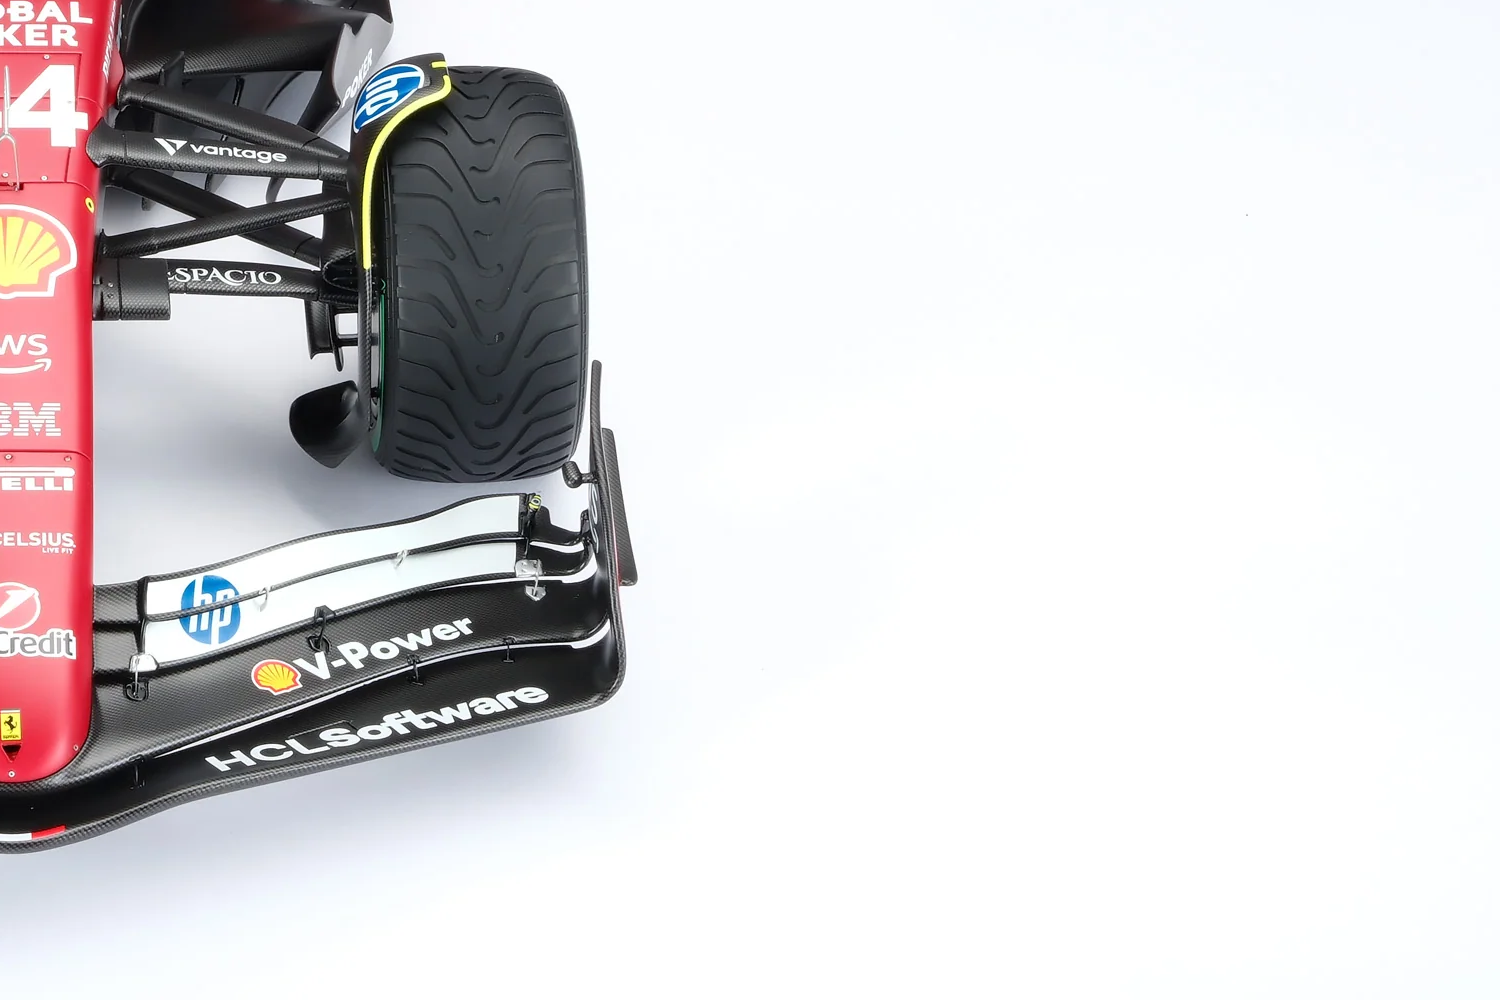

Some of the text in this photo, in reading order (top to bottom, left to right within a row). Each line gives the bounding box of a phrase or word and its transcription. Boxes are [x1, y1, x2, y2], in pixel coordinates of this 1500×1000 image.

[189, 143, 288, 164] vantage
[186, 575, 237, 644] hp
[293, 615, 473, 681] V-Power
